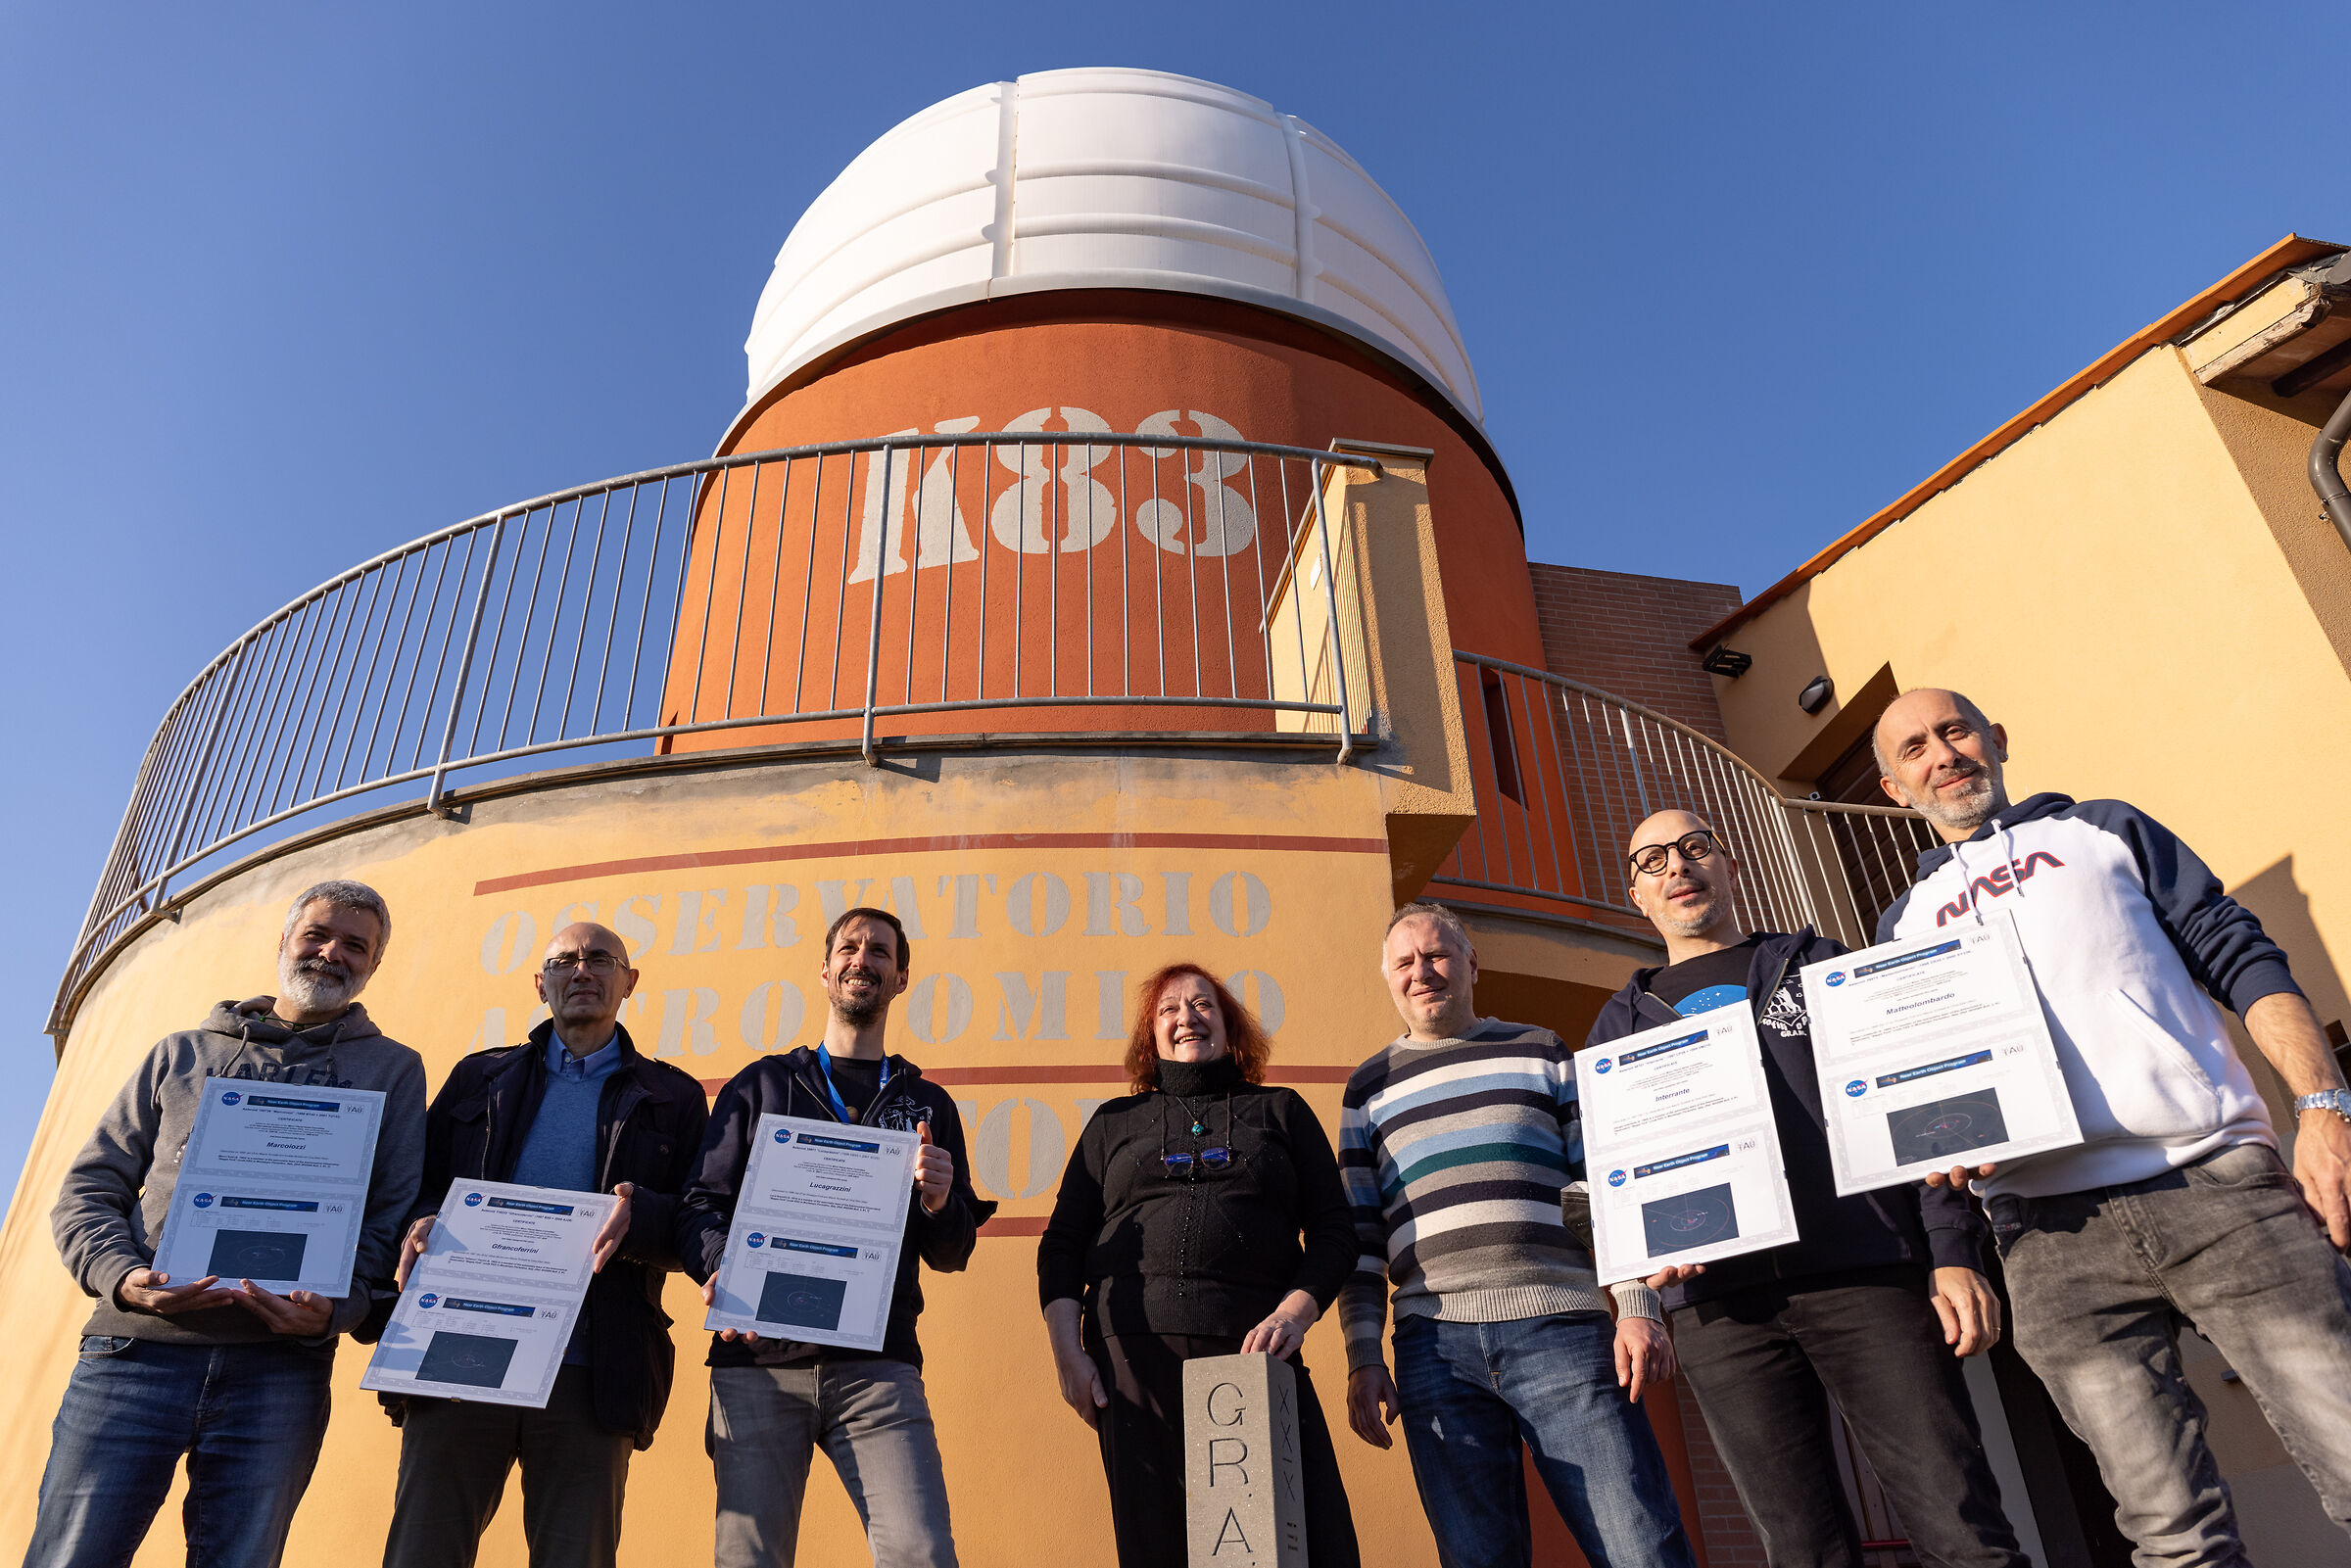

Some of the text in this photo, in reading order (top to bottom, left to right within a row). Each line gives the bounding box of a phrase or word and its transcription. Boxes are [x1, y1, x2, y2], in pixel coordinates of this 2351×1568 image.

[847, 406, 1255, 585] K83
[1937, 851, 2066, 927] NASA
[1916, 948, 1938, 958] Program
[1826, 974, 1845, 983] NASA
[1885, 991, 1955, 1015] Matteolombardo
[1671, 1038, 1688, 1047] Program
[1596, 1061, 1611, 1070] NASA
[1926, 1064, 1943, 1072] Object
[1943, 1059, 1966, 1069] Program
[1847, 1083, 1866, 1093] NASA
[1655, 1087, 1690, 1102] Interrante
[266, 1141, 306, 1150] Marcoiozzi
[1689, 1152, 1707, 1162] Program
[1607, 1173, 1625, 1182] NASA
[809, 1181, 850, 1193] Lucagrazzini
[491, 1243, 539, 1254] Gfrancoferrini
